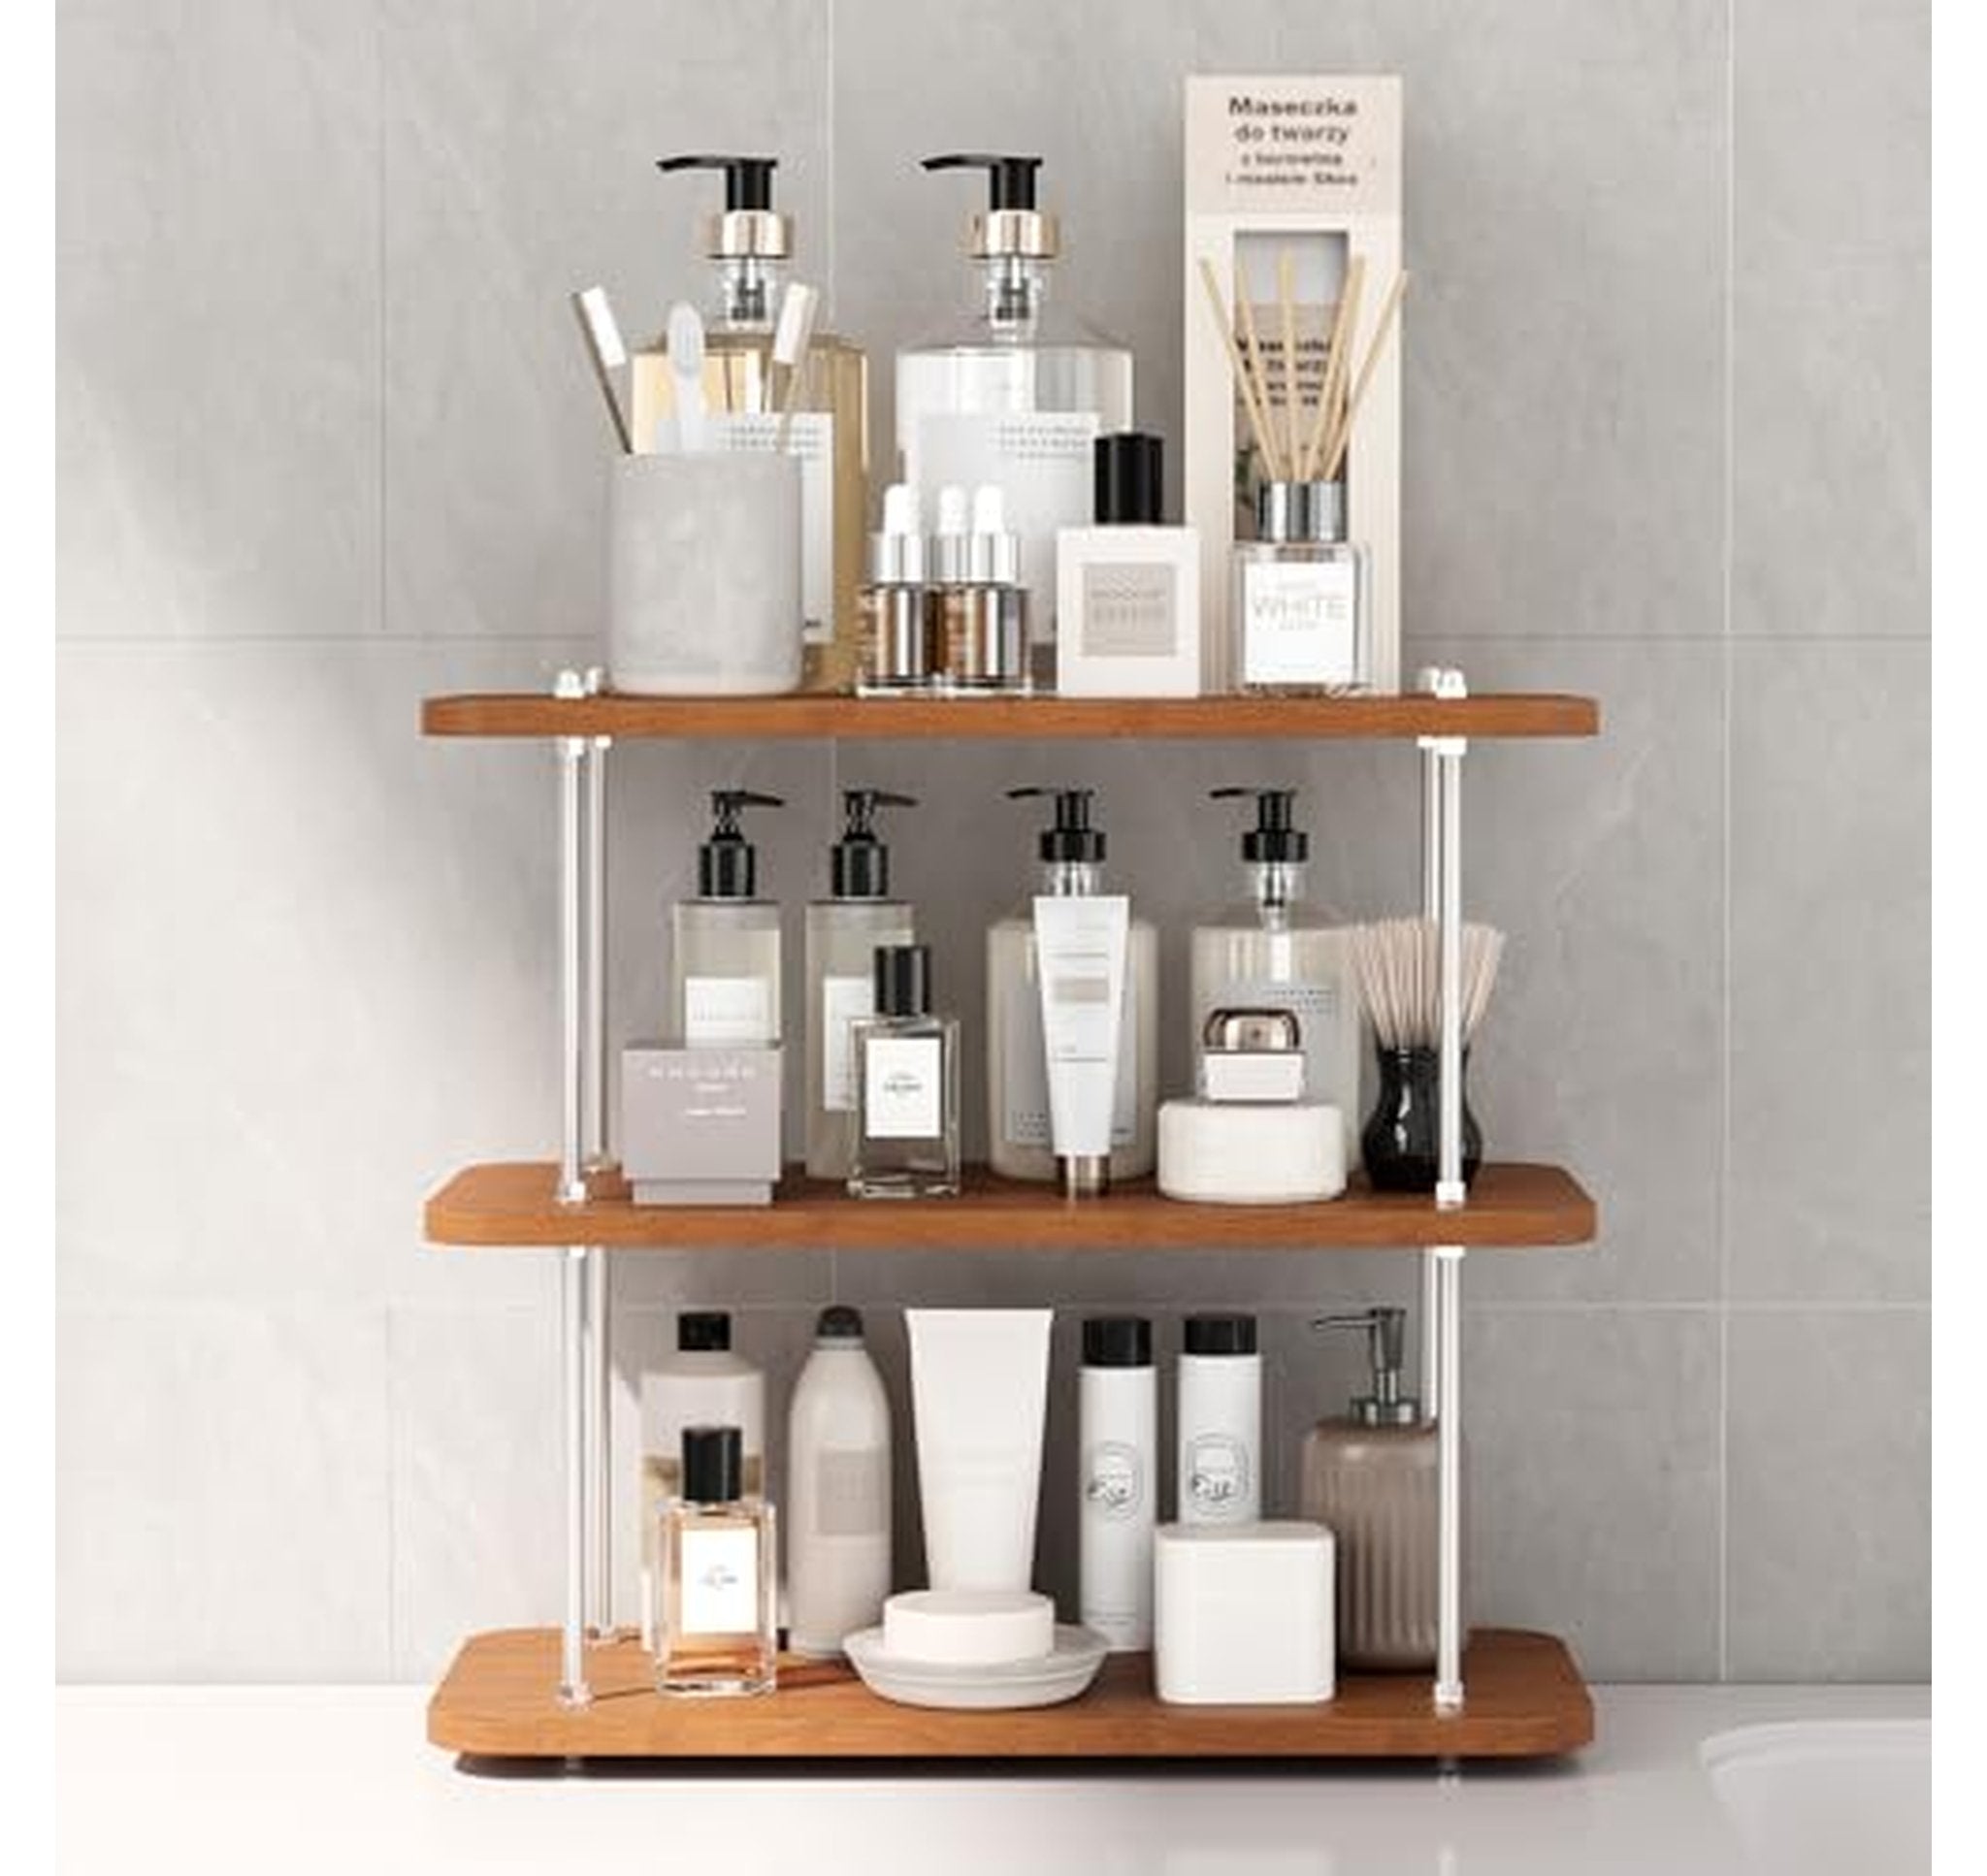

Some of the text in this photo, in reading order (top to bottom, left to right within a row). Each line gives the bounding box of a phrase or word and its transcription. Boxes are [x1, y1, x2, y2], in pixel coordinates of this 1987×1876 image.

[1227, 96, 1358, 115] Maseczka
[1235, 124, 1351, 146] do twarzy
[1252, 596, 1348, 620] WHITE
